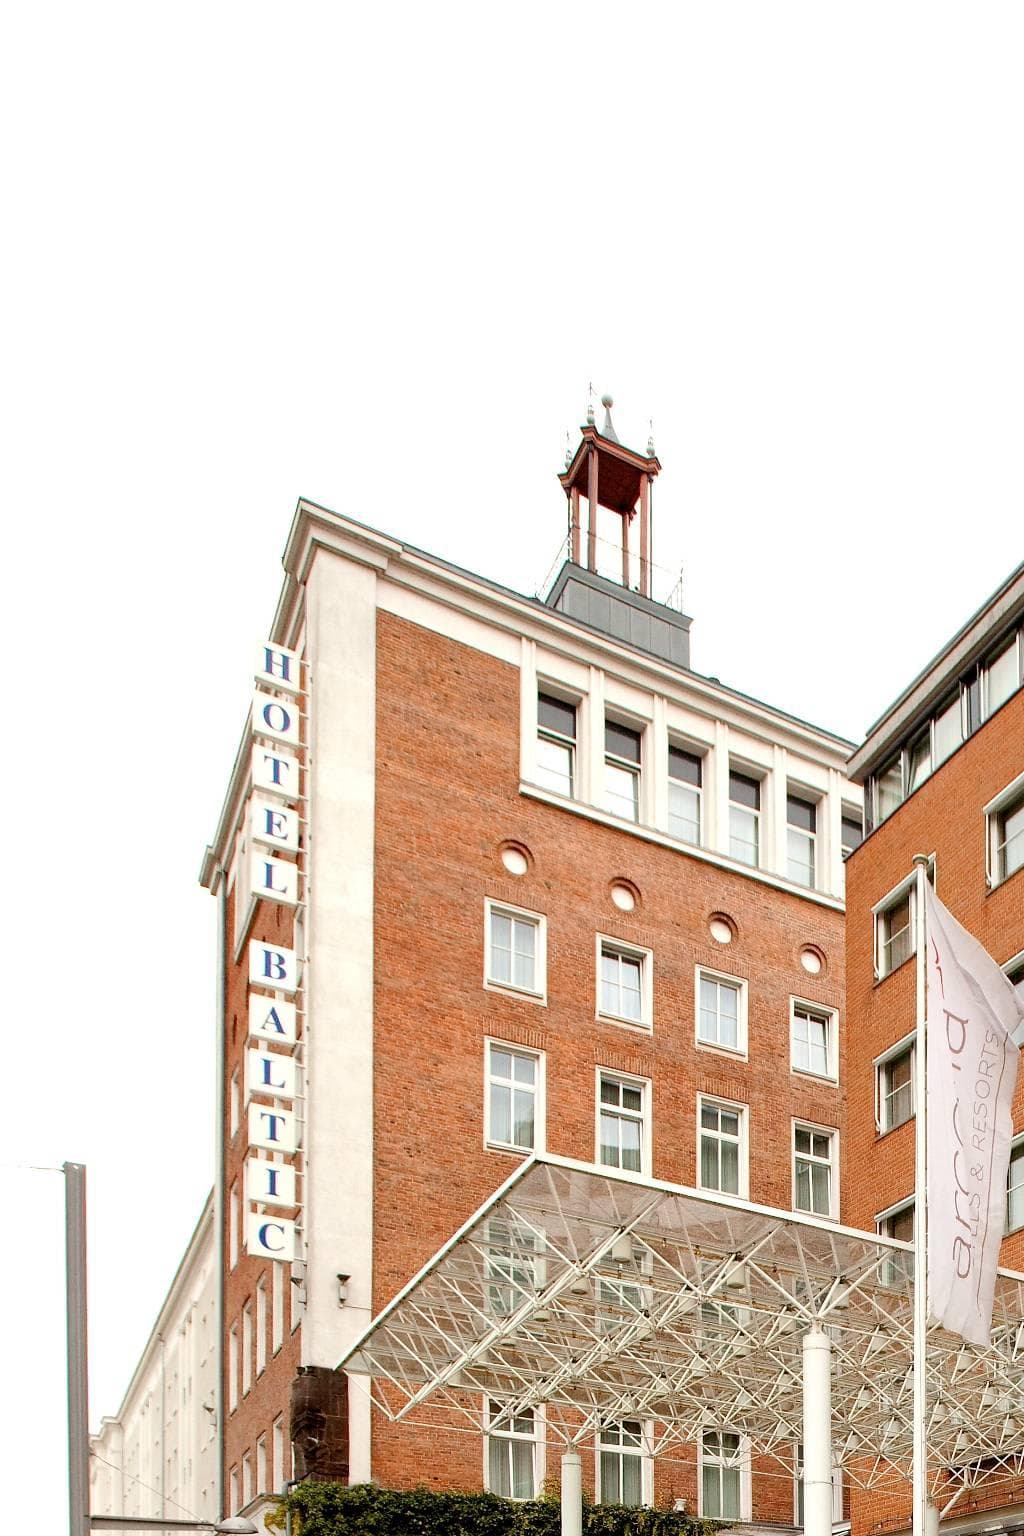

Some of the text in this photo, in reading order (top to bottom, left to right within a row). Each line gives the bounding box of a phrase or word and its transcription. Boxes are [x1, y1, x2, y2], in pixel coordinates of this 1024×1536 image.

[257, 646, 294, 1252] HOTEL BALTIC
[971, 1029, 1001, 1152] RESORTS
